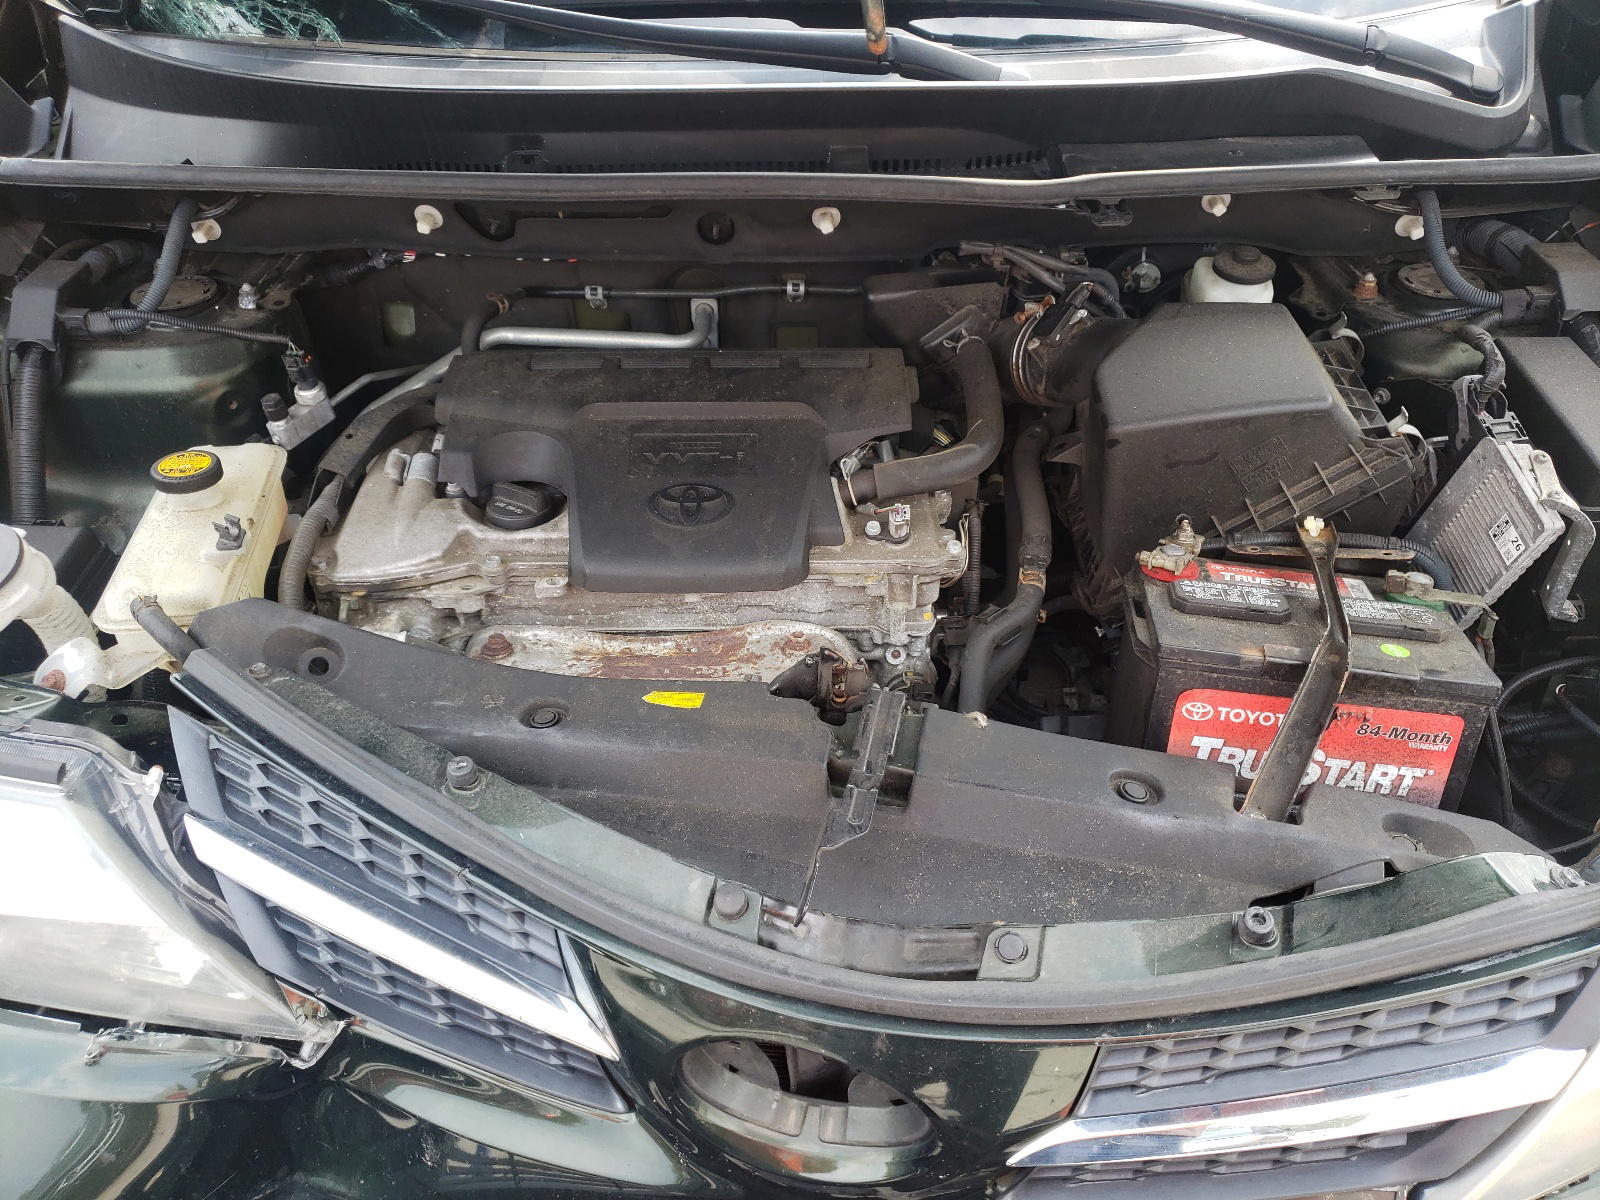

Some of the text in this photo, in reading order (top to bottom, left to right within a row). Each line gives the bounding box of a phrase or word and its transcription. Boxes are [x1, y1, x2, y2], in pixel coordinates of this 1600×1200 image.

[1511, 536, 1523, 552] 26
[1227, 566, 1266, 575] TOYOTA
[1219, 571, 1317, 591] TRUESTA
[1217, 706, 1286, 727] TOYOT
[1356, 723, 1453, 745] 84-Month
[1408, 741, 1449, 753] WARRANTY
[1190, 735, 1427, 798] TRUSTART
